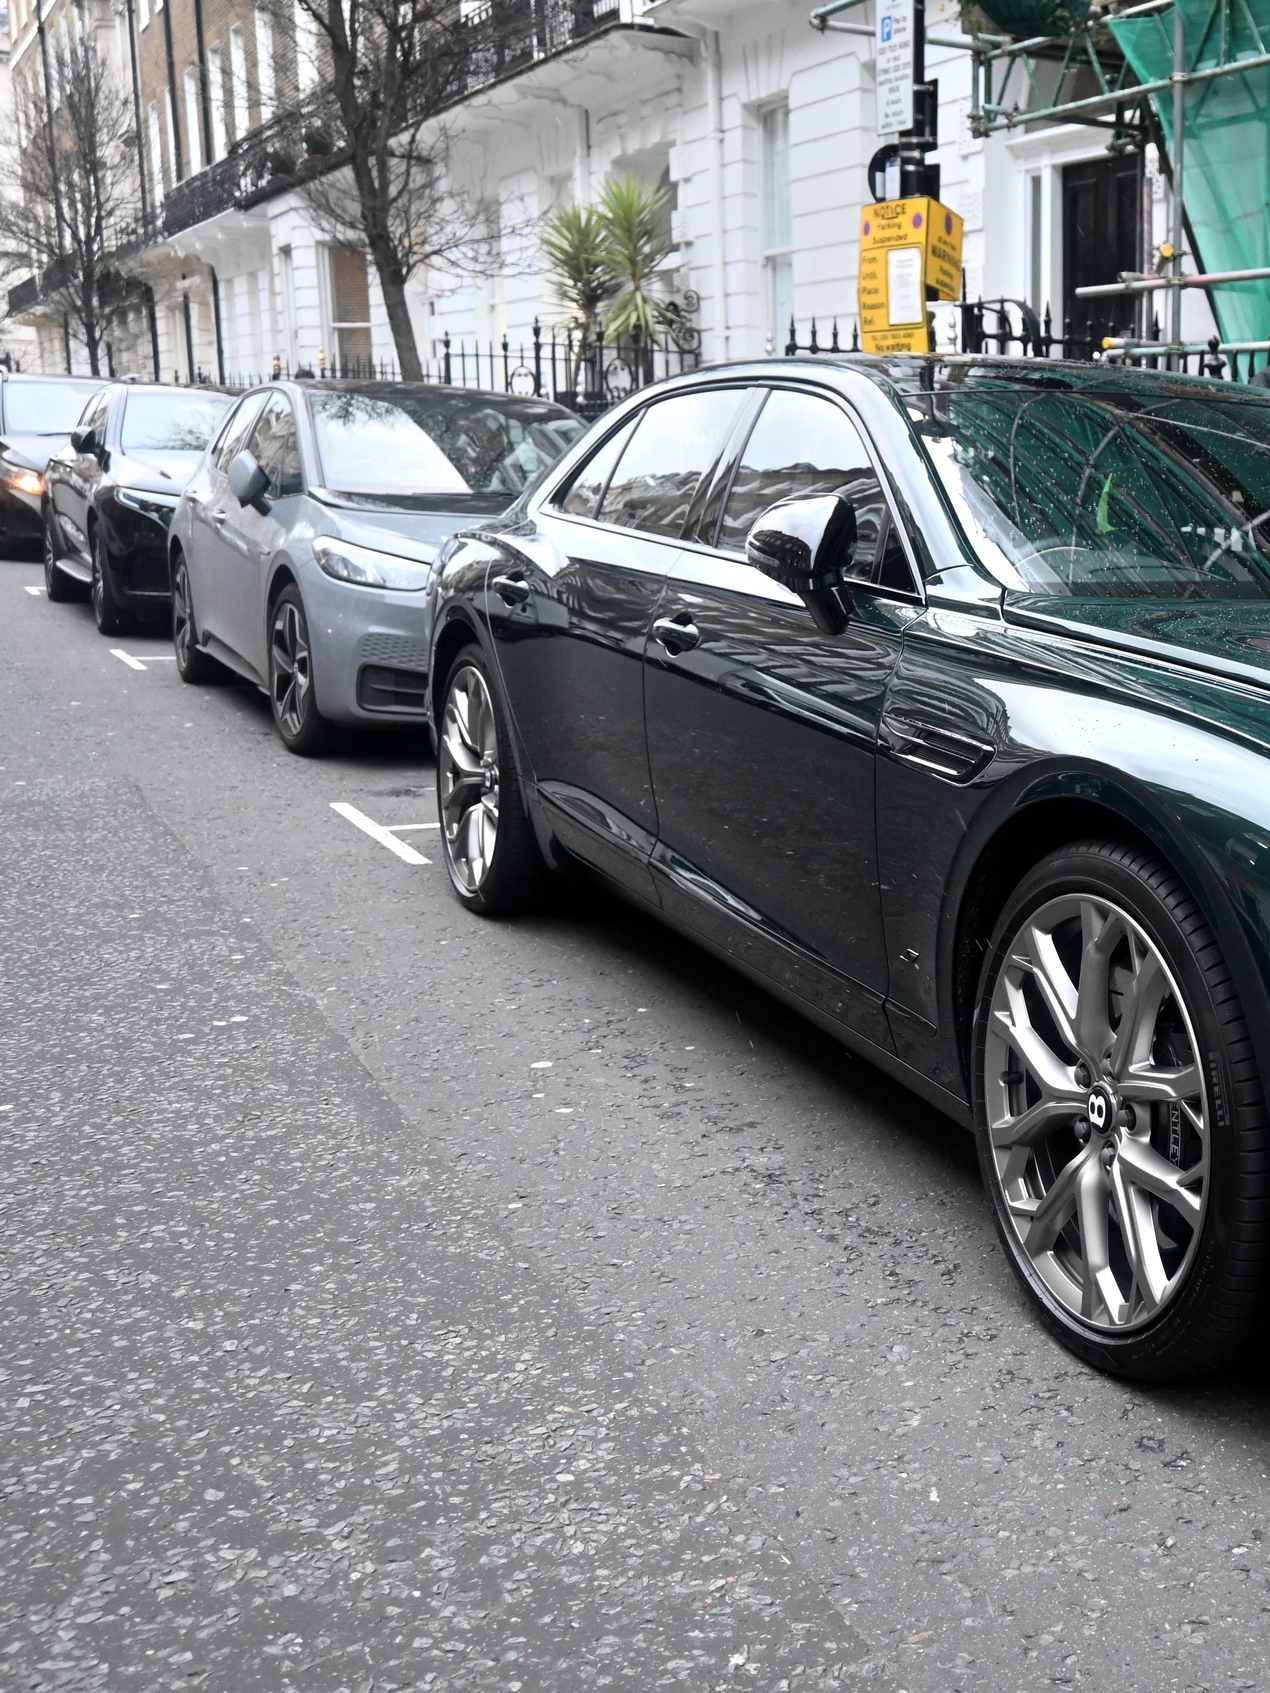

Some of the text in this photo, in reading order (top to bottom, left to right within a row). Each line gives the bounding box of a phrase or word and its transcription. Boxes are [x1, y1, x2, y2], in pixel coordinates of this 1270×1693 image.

[873, 203, 907, 218] NOTICE
[875, 341, 911, 352] No waiting
[1170, 1103, 1179, 1168] NTLEY
